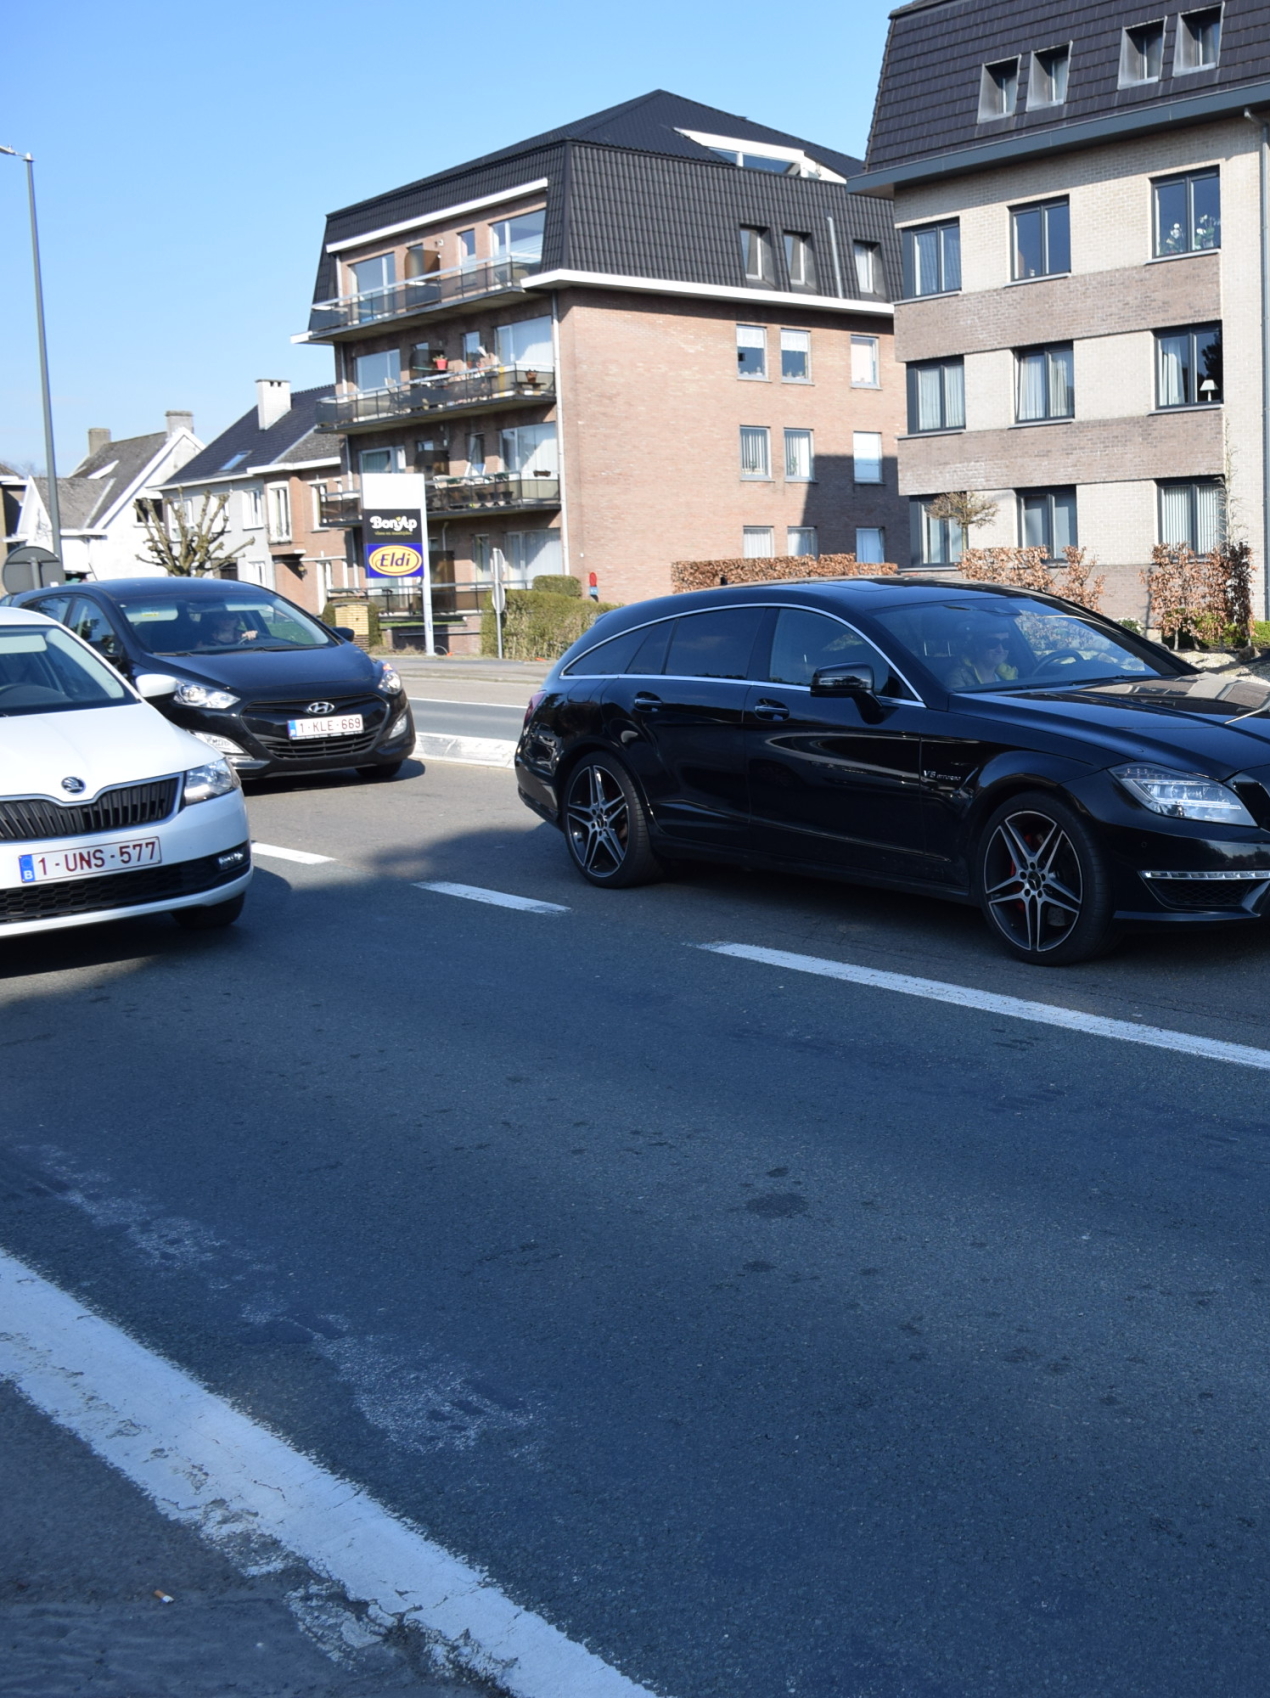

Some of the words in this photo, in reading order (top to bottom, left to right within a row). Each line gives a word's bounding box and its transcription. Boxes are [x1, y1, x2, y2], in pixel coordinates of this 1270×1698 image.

[379, 552, 411, 567] Eldi
[38, 841, 156, 876] 1-UNS-577
[24, 870, 33, 880] B
